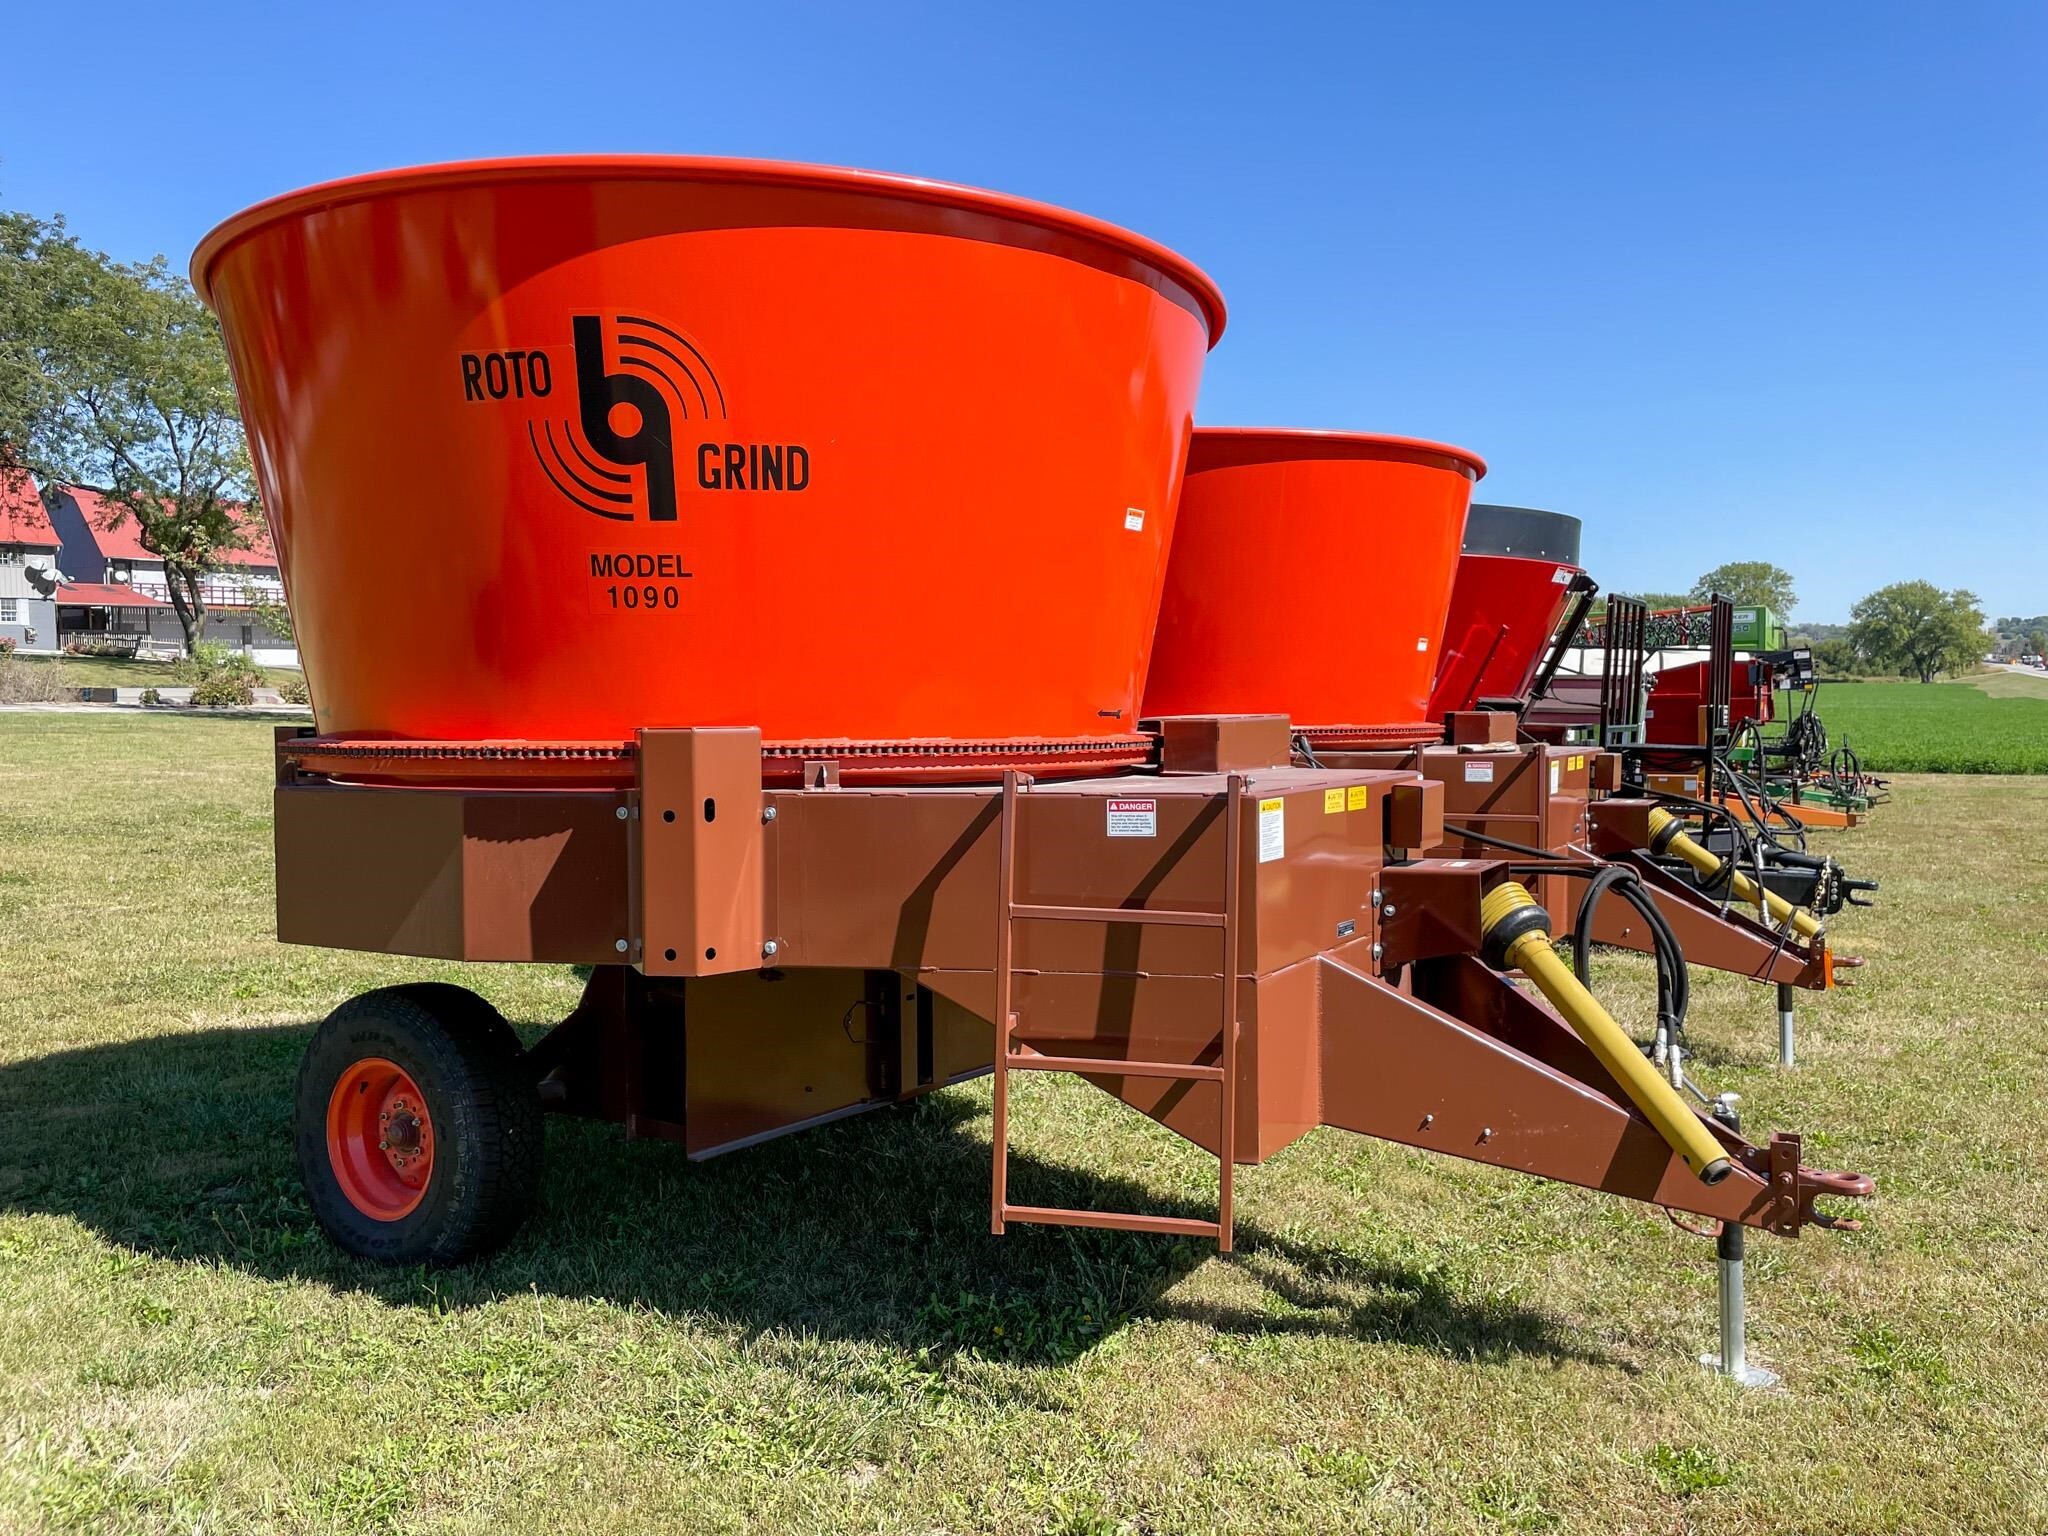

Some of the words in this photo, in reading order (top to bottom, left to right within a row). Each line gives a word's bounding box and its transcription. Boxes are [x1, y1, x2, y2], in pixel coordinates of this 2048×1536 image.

[461, 350, 551, 401] ROTO
[697, 443, 809, 491] GRIND
[590, 553, 693, 578] MODEL
[606, 586, 680, 608] 1090
